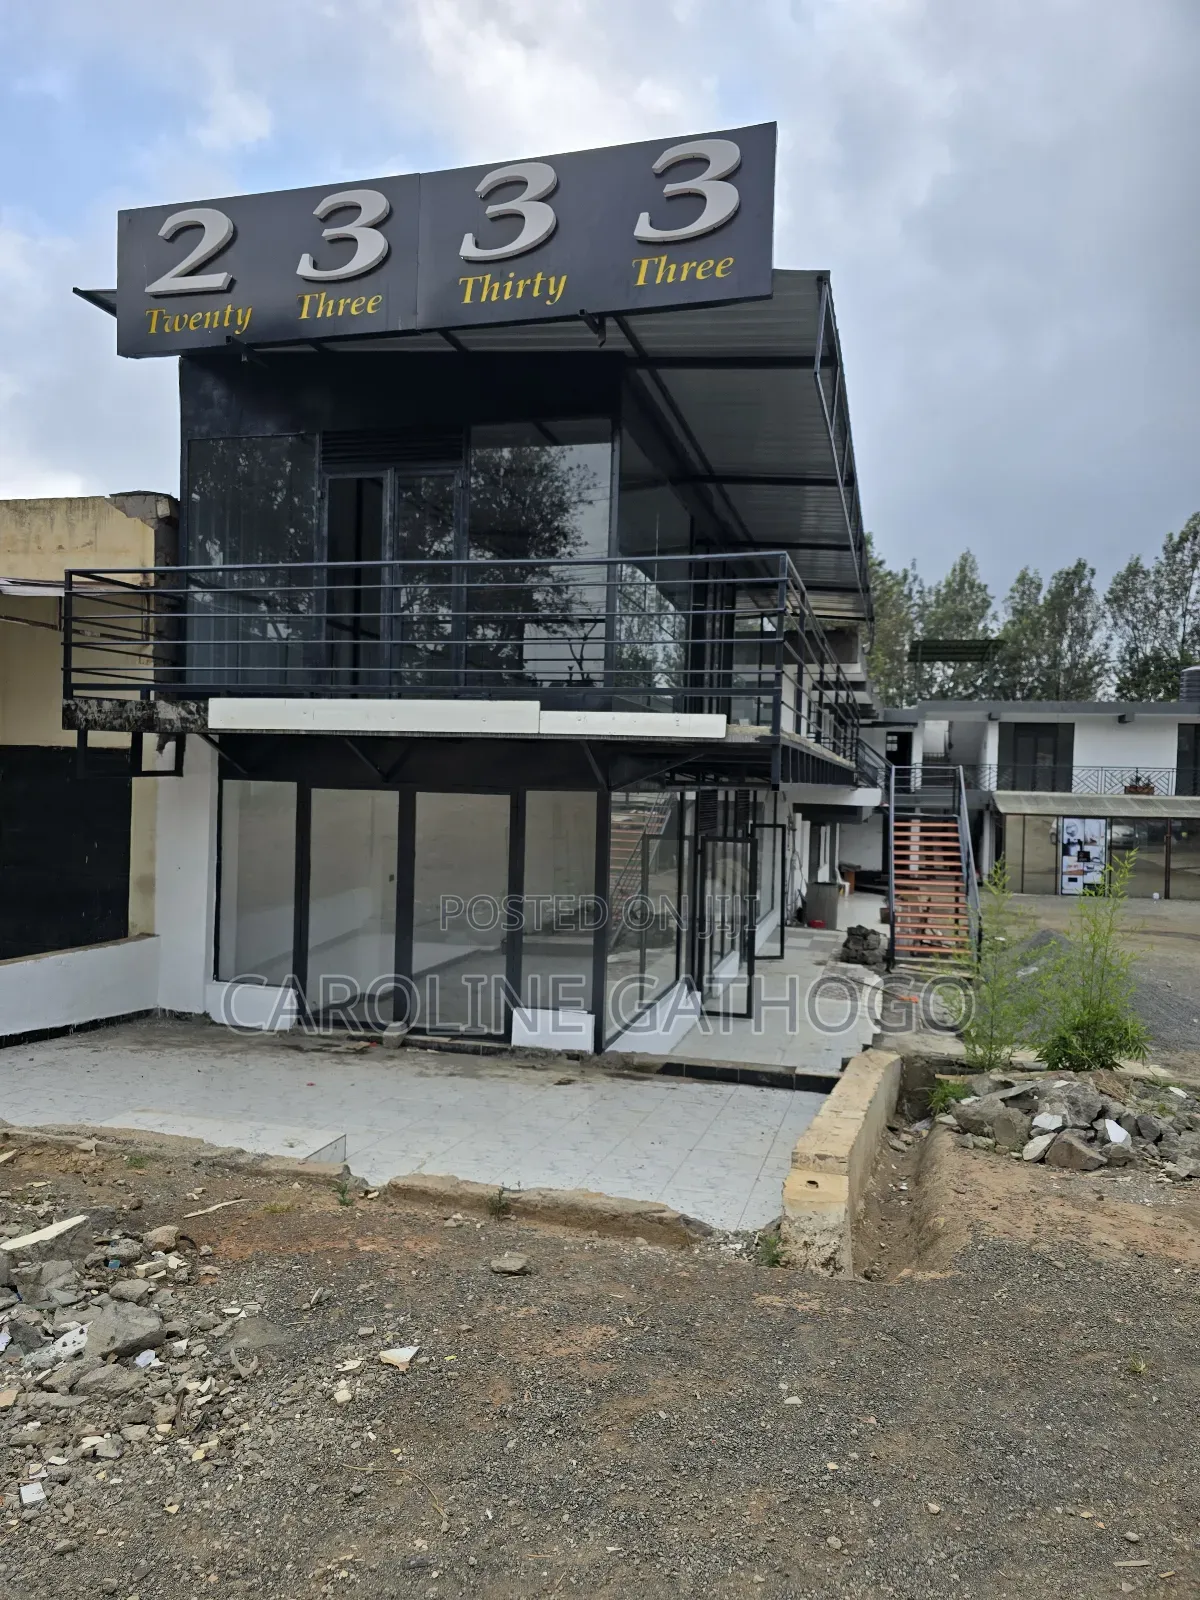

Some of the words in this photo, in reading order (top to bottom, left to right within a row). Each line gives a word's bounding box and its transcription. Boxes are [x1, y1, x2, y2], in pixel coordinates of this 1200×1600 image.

[145, 207, 235, 296] 2
[296, 189, 391, 282] 3
[458, 161, 558, 262] 3
[632, 138, 742, 243] 3
[146, 303, 253, 336] Twenty
[297, 291, 383, 321] Three
[458, 267, 568, 306] Thirty
[632, 254, 735, 287] Three
